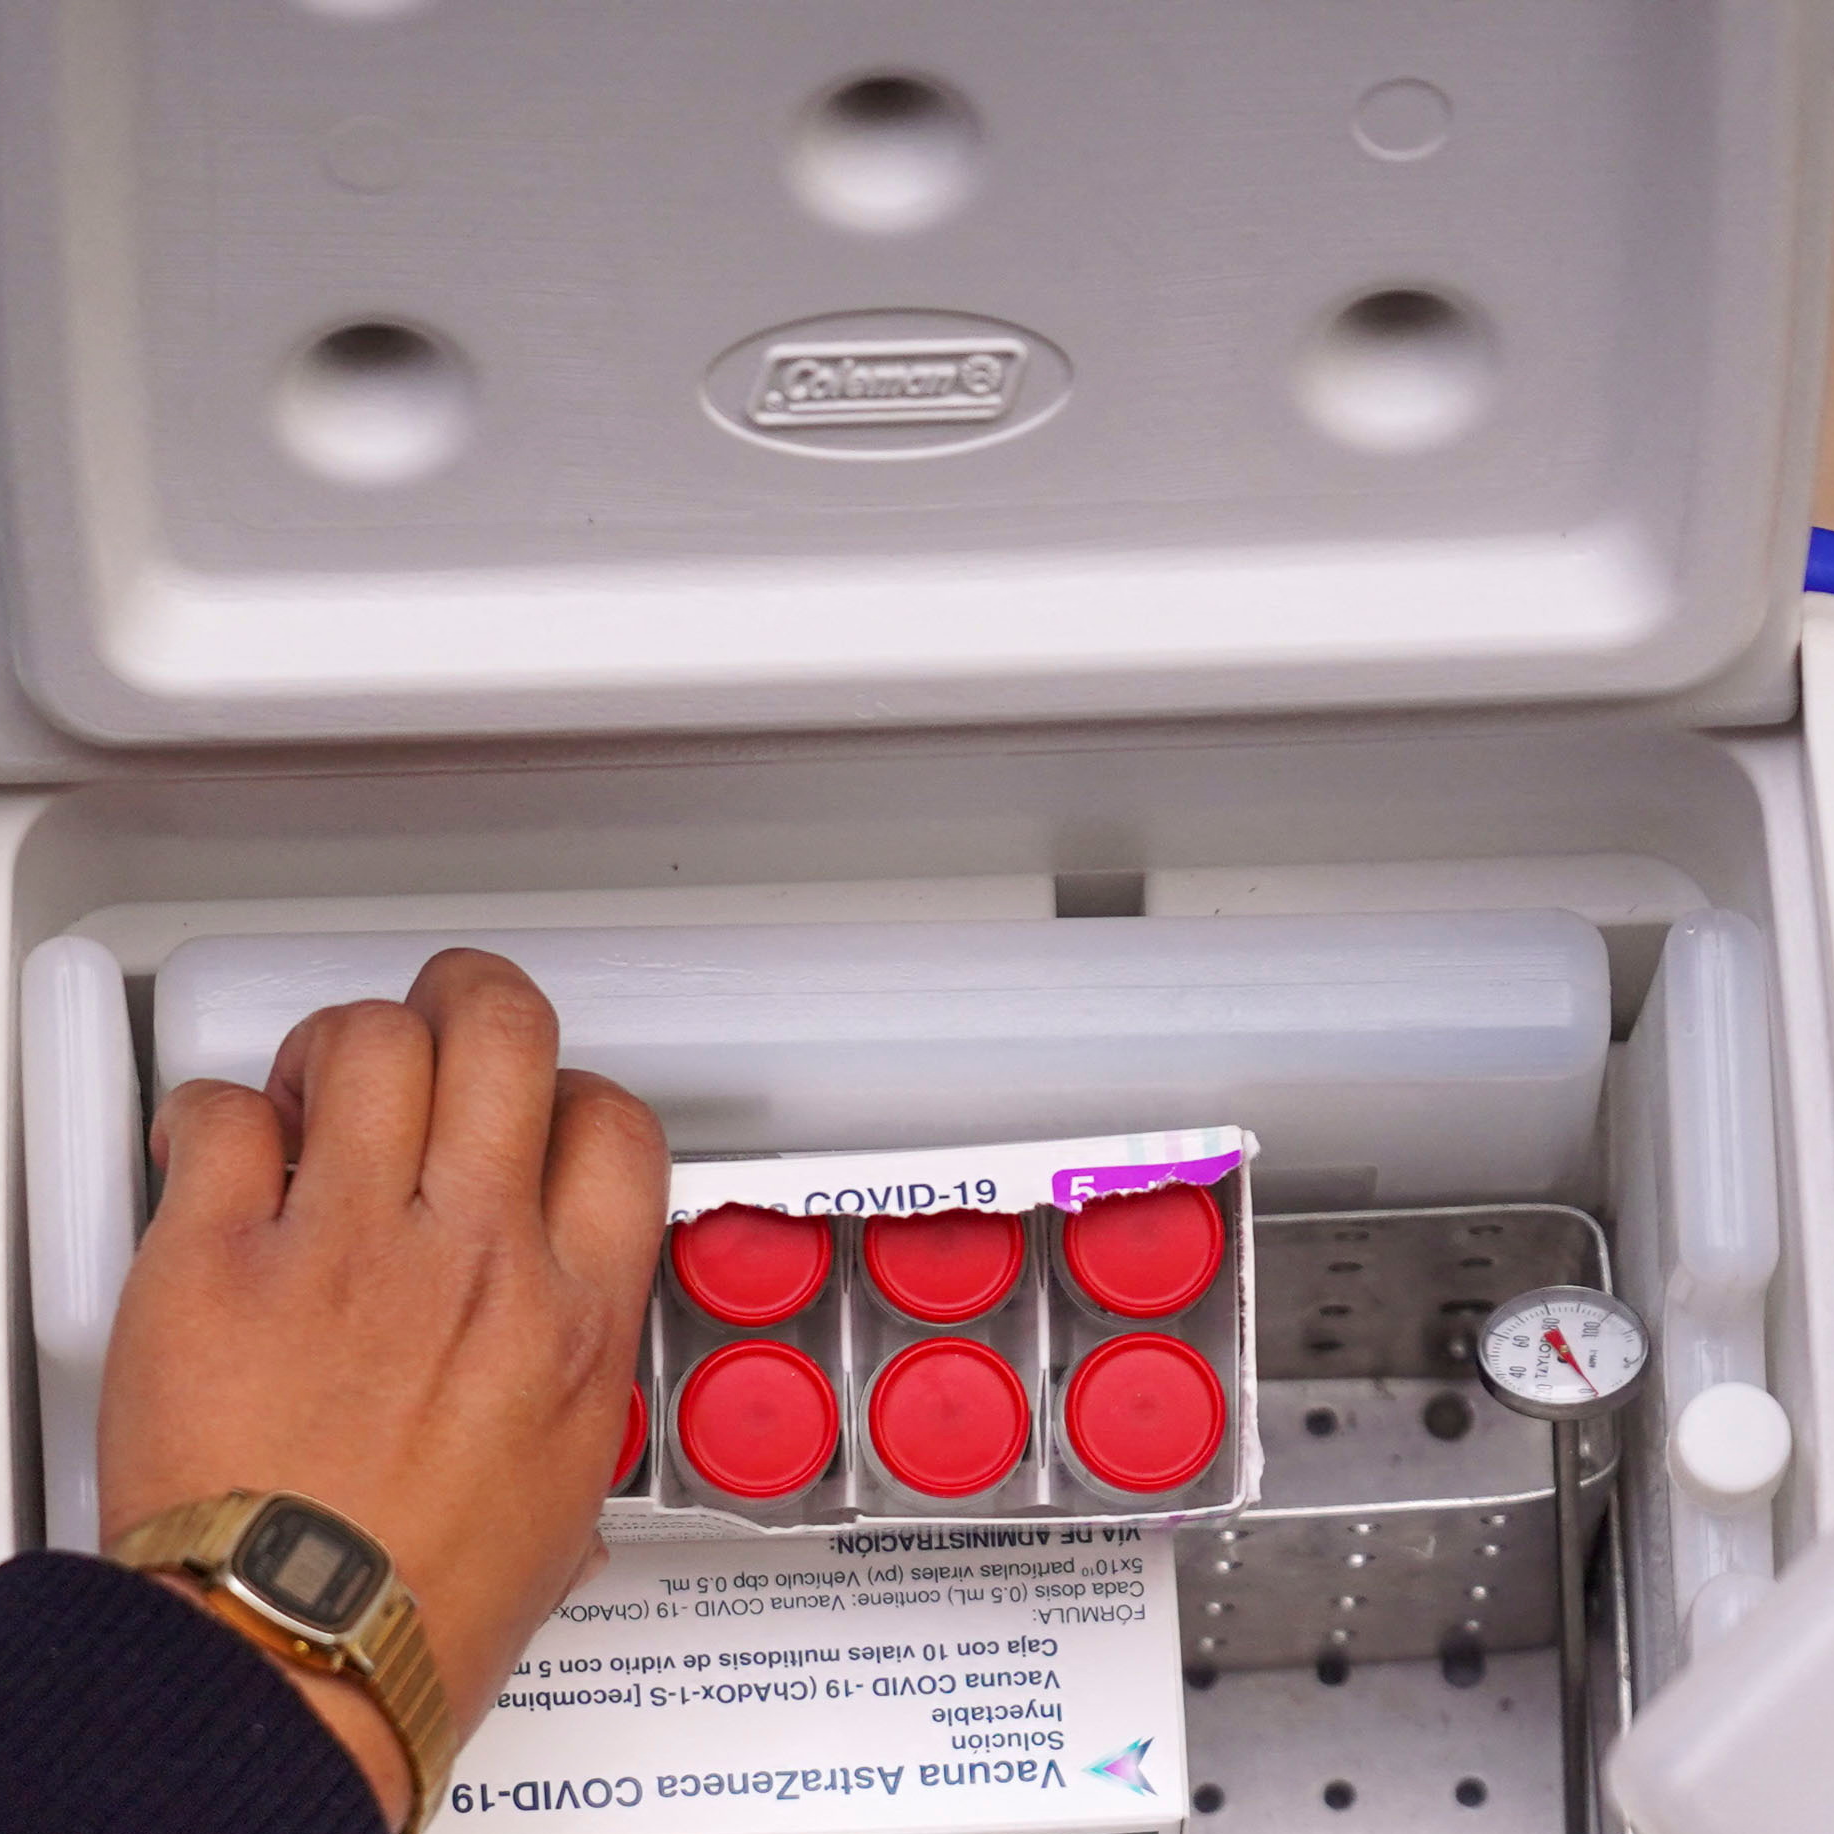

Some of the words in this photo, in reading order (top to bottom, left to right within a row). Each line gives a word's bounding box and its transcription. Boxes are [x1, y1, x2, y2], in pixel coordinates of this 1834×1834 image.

[804, 1179, 997, 1216] COVID-19
[1582, 1321, 1601, 1338] 100
[1512, 1335, 1530, 1348] 60
[1509, 1366, 1527, 1379] 40
[867, 1563, 904, 1588] (pv)
[910, 1565, 974, 1584] virales
[980, 1557, 1075, 1582] partículas
[659, 1578, 690, 1597] mL
[697, 1576, 727, 1594] 0.5
[733, 1571, 769, 1593] cbp
[775, 1571, 859, 1592] Vehículo
[1034, 1583, 1086, 1601] dosis
[1092, 1580, 1144, 1599] Cada
[771, 1594, 845, 1613] Vacuna
[852, 1589, 940, 1608] contiene:
[947, 1586, 984, 1607] mL)
[992, 1583, 1028, 1604] (0.5
[656, 1600, 688, 1620] -19
[695, 1597, 764, 1619] COVID
[1032, 1603, 1146, 1625] FÓRMULA:
[848, 1644, 915, 1664] viales
[923, 1643, 948, 1661] 10
[957, 1640, 999, 1659] con
[1007, 1635, 1058, 1658] Caja
[538, 1660, 551, 1679] 5
[559, 1658, 602, 1677] con
[609, 1655, 675, 1676] vidrio
[683, 1653, 711, 1672] de
[718, 1648, 841, 1671] multidosis
[650, 1675, 818, 1704] (ChAdOx-1-S
[825, 1678, 864, 1699] -19
[871, 1673, 956, 1696] COVID
[965, 1670, 1060, 1691] Vacuna
[492, 1682, 641, 1711] [recombina
[932, 1699, 1062, 1727] Inyectable
[951, 1730, 1065, 1755] Solución
[656, 1766, 905, 1797] AstraZeneca
[919, 1759, 1066, 1789] Vacuna
[452, 1776, 643, 1813] COVID-19
